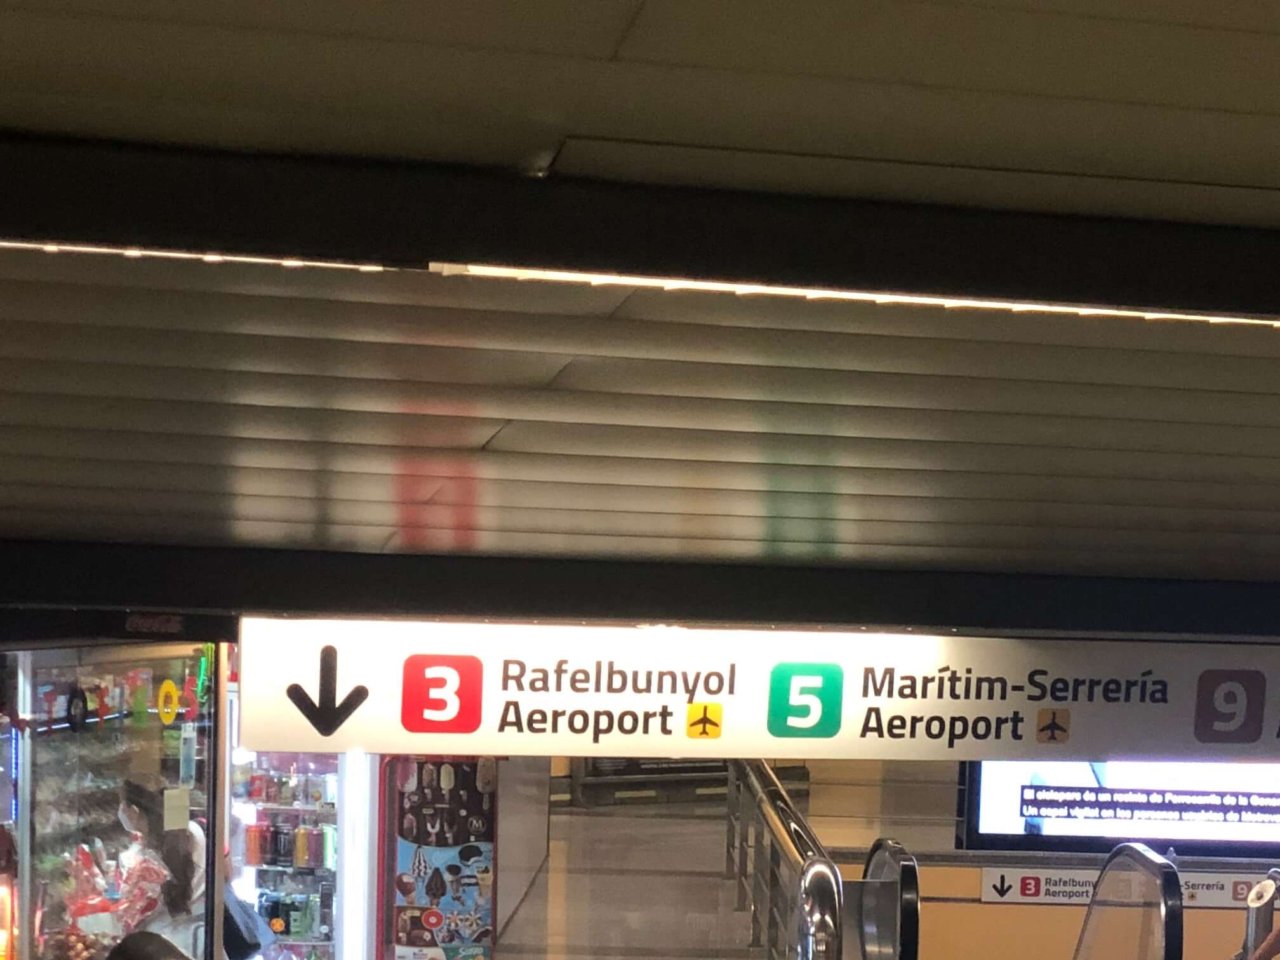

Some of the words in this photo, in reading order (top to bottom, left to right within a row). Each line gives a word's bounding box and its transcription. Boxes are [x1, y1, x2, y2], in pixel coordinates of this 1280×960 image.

[423, 666, 461, 722] 3
[501, 659, 736, 704] Rafelbunyol
[786, 675, 823, 729] 5
[861, 665, 1169, 704] Marítim-Serrería
[497, 700, 673, 744] Aeroport
[859, 706, 1024, 748] Aeroport
[1212, 681, 1248, 732] 9
[1025, 879, 1036, 894] 3
[1044, 877, 1098, 890] Rafelbuny
[1044, 889, 1090, 899] Aeroport
[1237, 884, 1248, 898] 9
